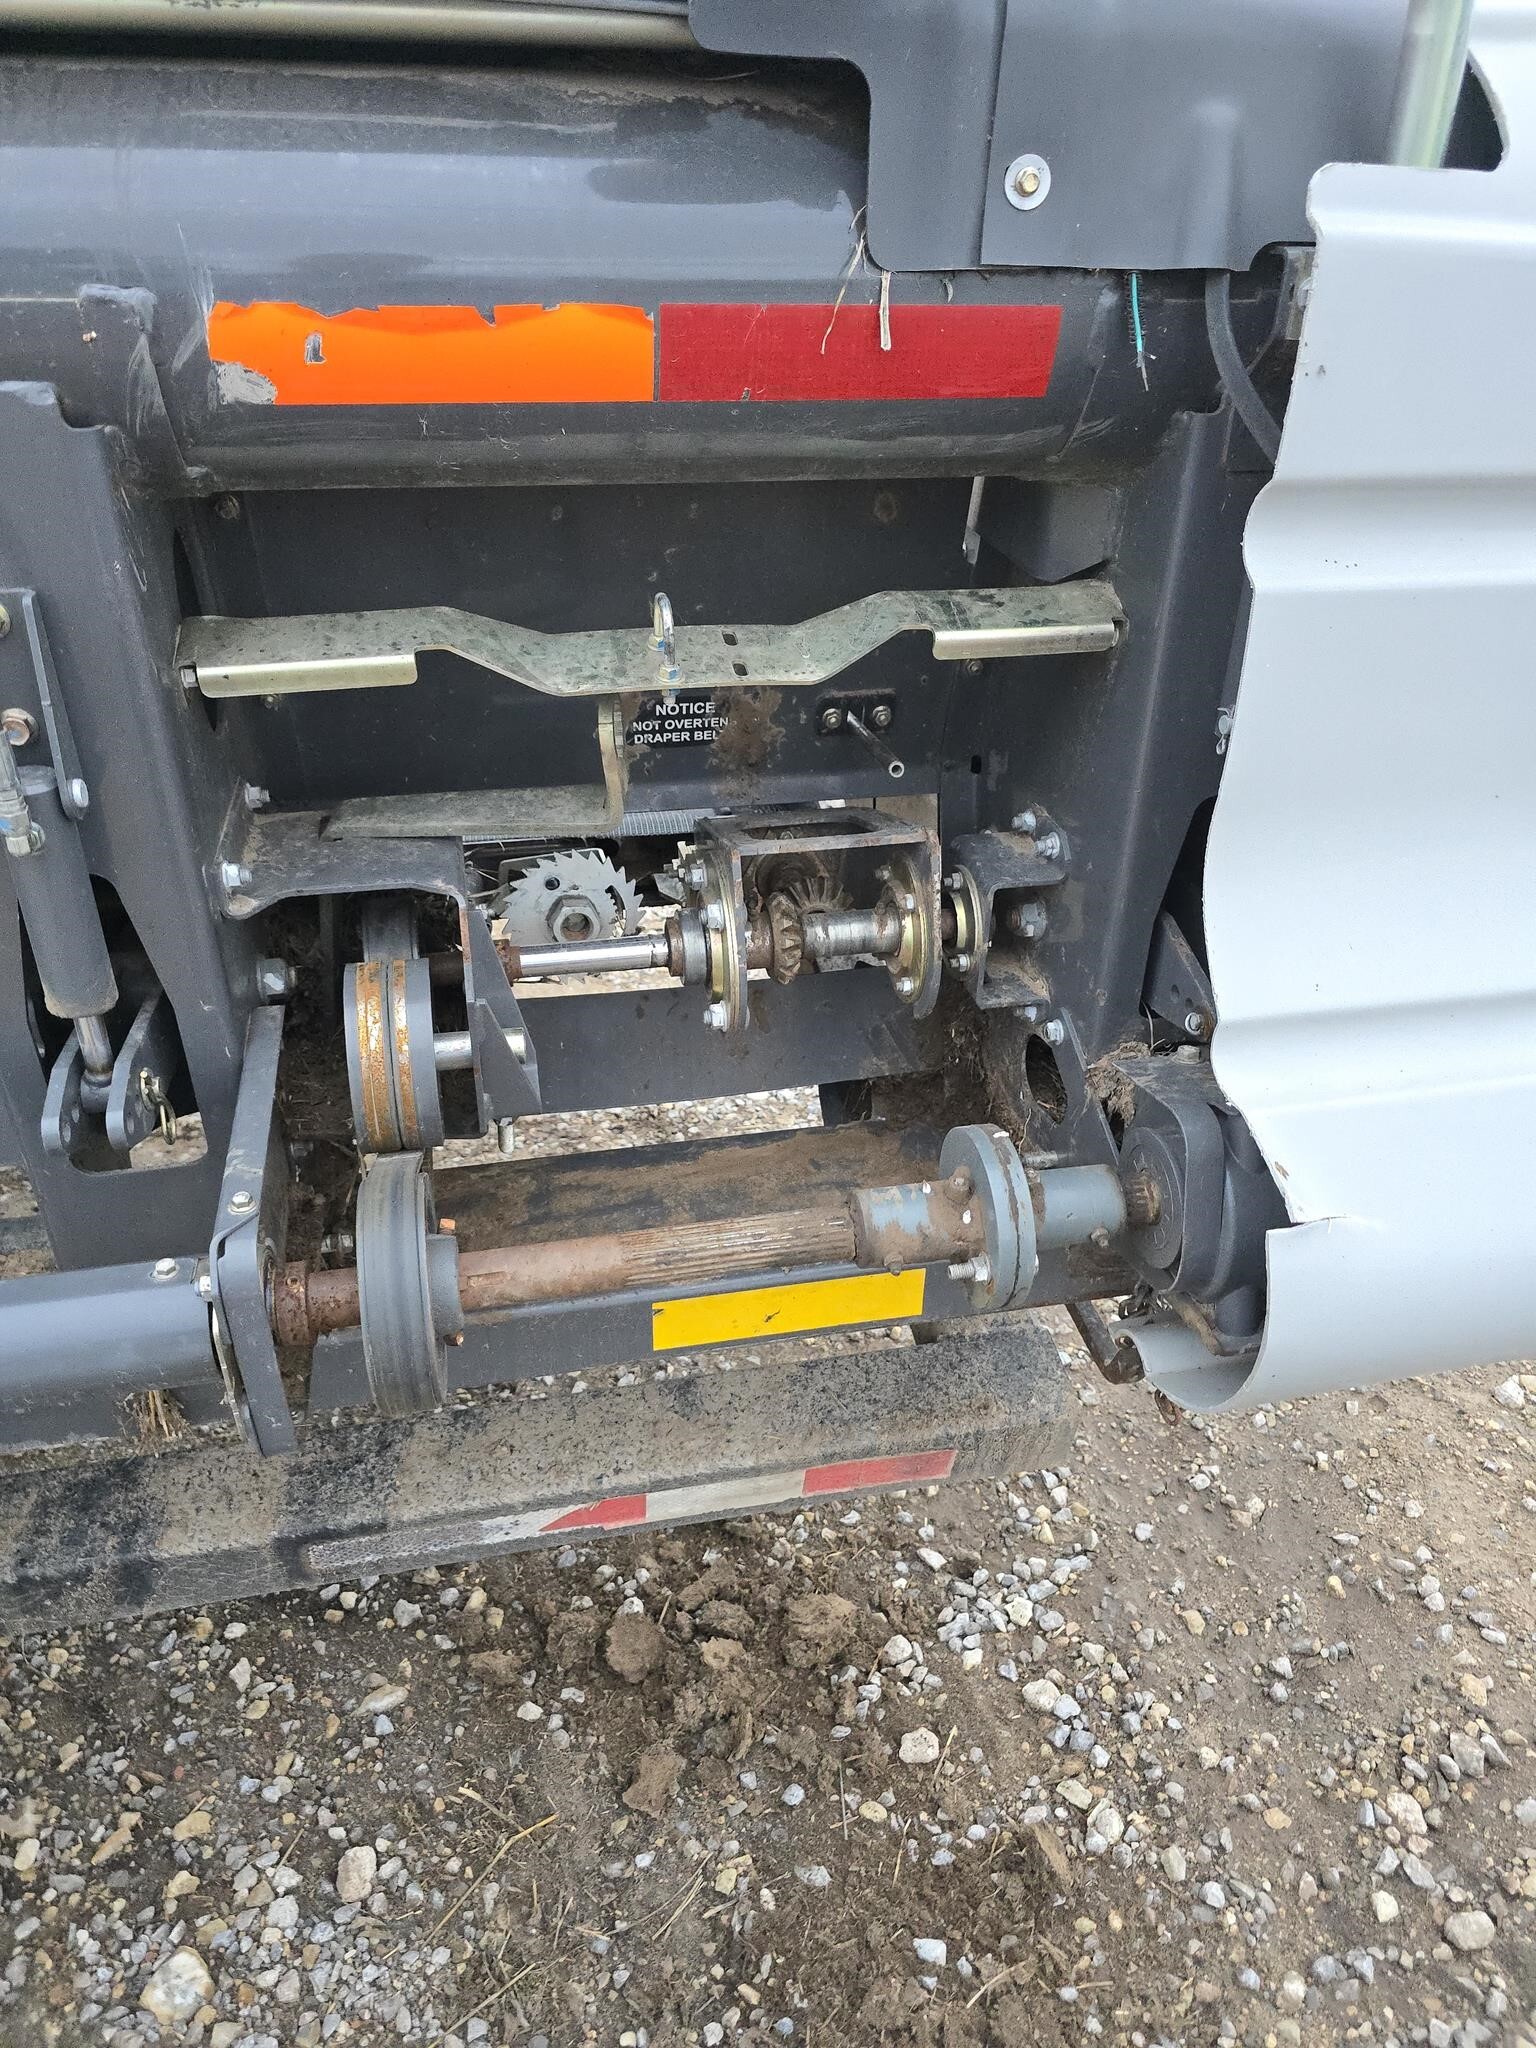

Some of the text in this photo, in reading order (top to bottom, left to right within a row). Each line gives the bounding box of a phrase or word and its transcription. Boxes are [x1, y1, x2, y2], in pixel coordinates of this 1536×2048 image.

[655, 702, 716, 716] NOTICE
[632, 717, 730, 732] NOT OVERTEN
[634, 730, 724, 744] DRAPER BEL
